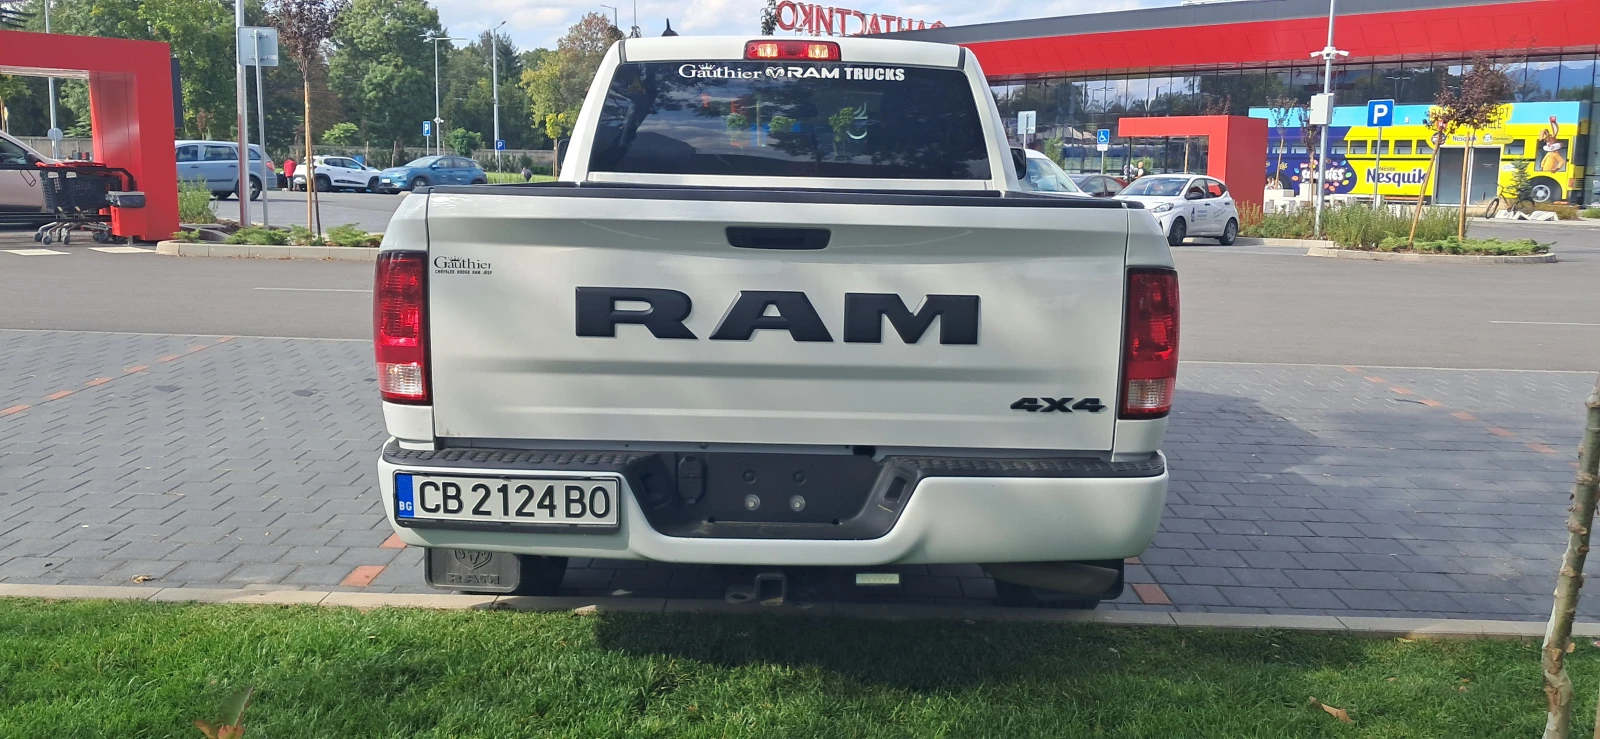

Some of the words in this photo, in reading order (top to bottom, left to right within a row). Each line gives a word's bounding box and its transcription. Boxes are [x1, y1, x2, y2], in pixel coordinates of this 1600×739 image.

[678, 63, 762, 79] Gauthier
[787, 66, 840, 79] RAM
[843, 67, 905, 81] TRUCKS
[1373, 104, 1388, 125] P
[1366, 168, 1428, 188] Nesquik
[433, 256, 492, 269] Gauthier
[575, 286, 981, 345] RAM
[399, 501, 412, 511] BG
[419, 481, 463, 514] CB
[471, 483, 557, 518] 2124
[565, 485, 610, 518] BO
[446, 572, 500, 585] RAM
